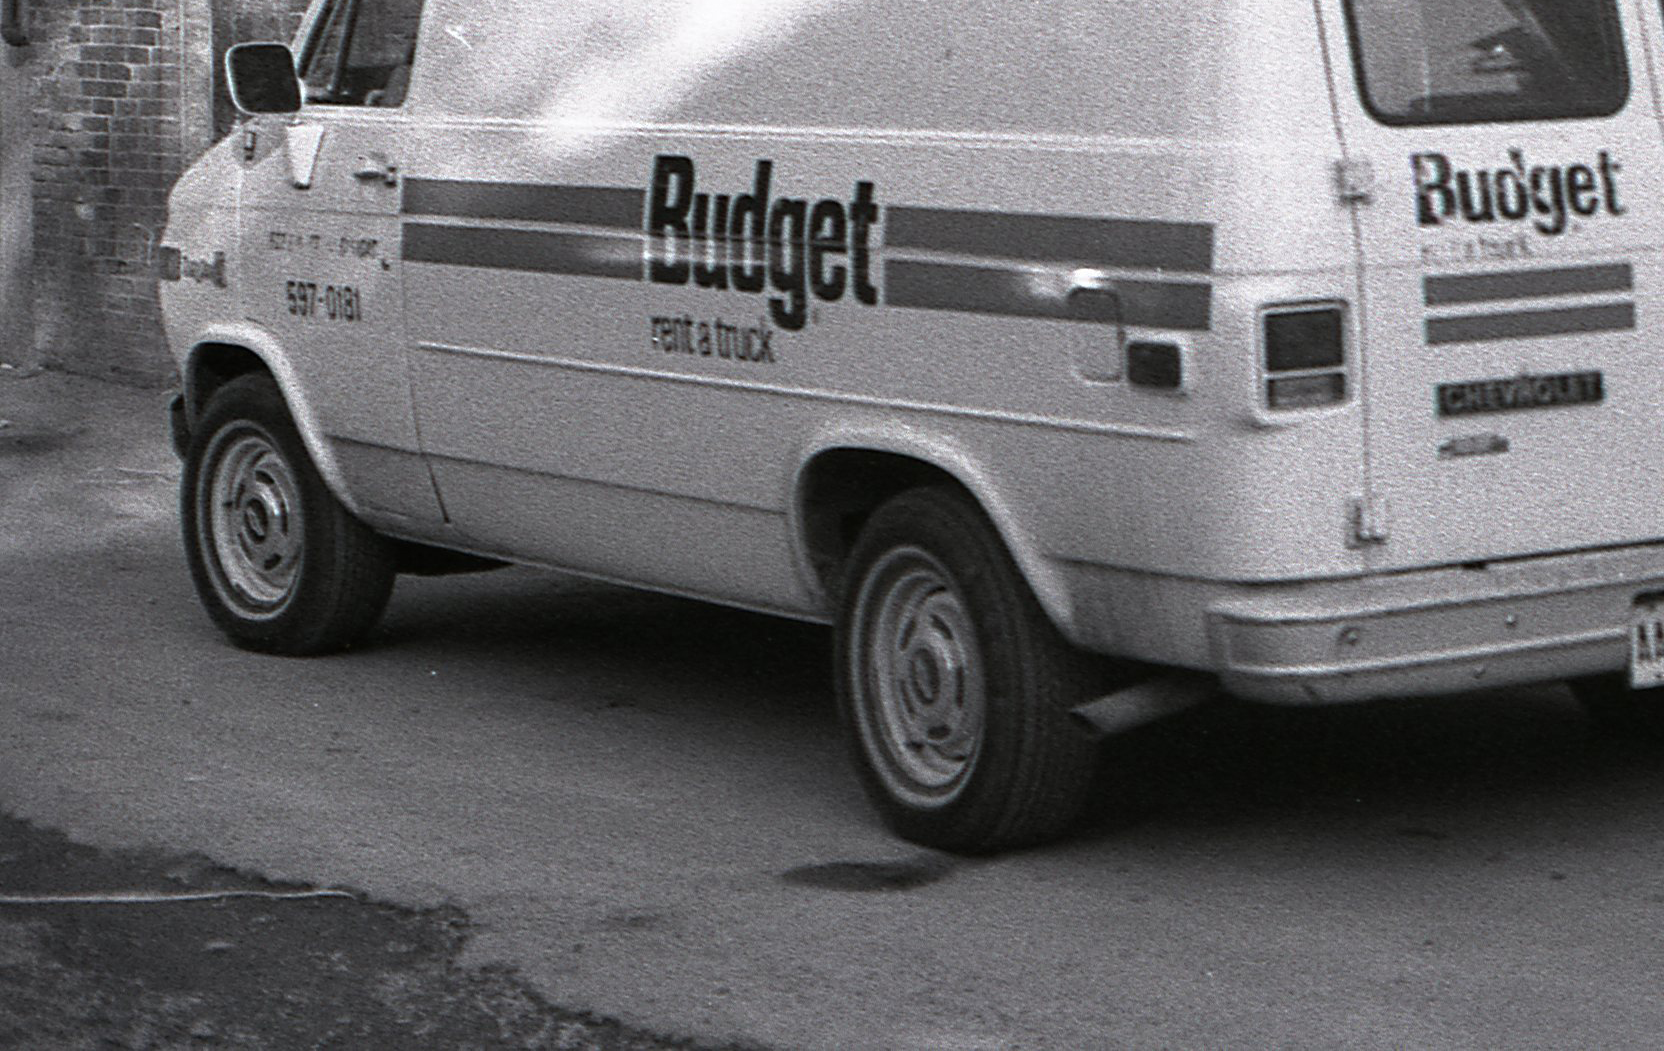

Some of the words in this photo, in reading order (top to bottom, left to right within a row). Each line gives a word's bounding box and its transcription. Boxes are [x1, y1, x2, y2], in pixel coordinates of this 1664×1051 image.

[1410, 148, 1628, 237] Budget
[649, 155, 878, 331] Budget
[286, 280, 362, 322] 597-0181
[651, 314, 695, 355] rent
[698, 321, 712, 357] a
[715, 316, 776, 364] truck
[1445, 373, 1599, 411] CHEVROLET
